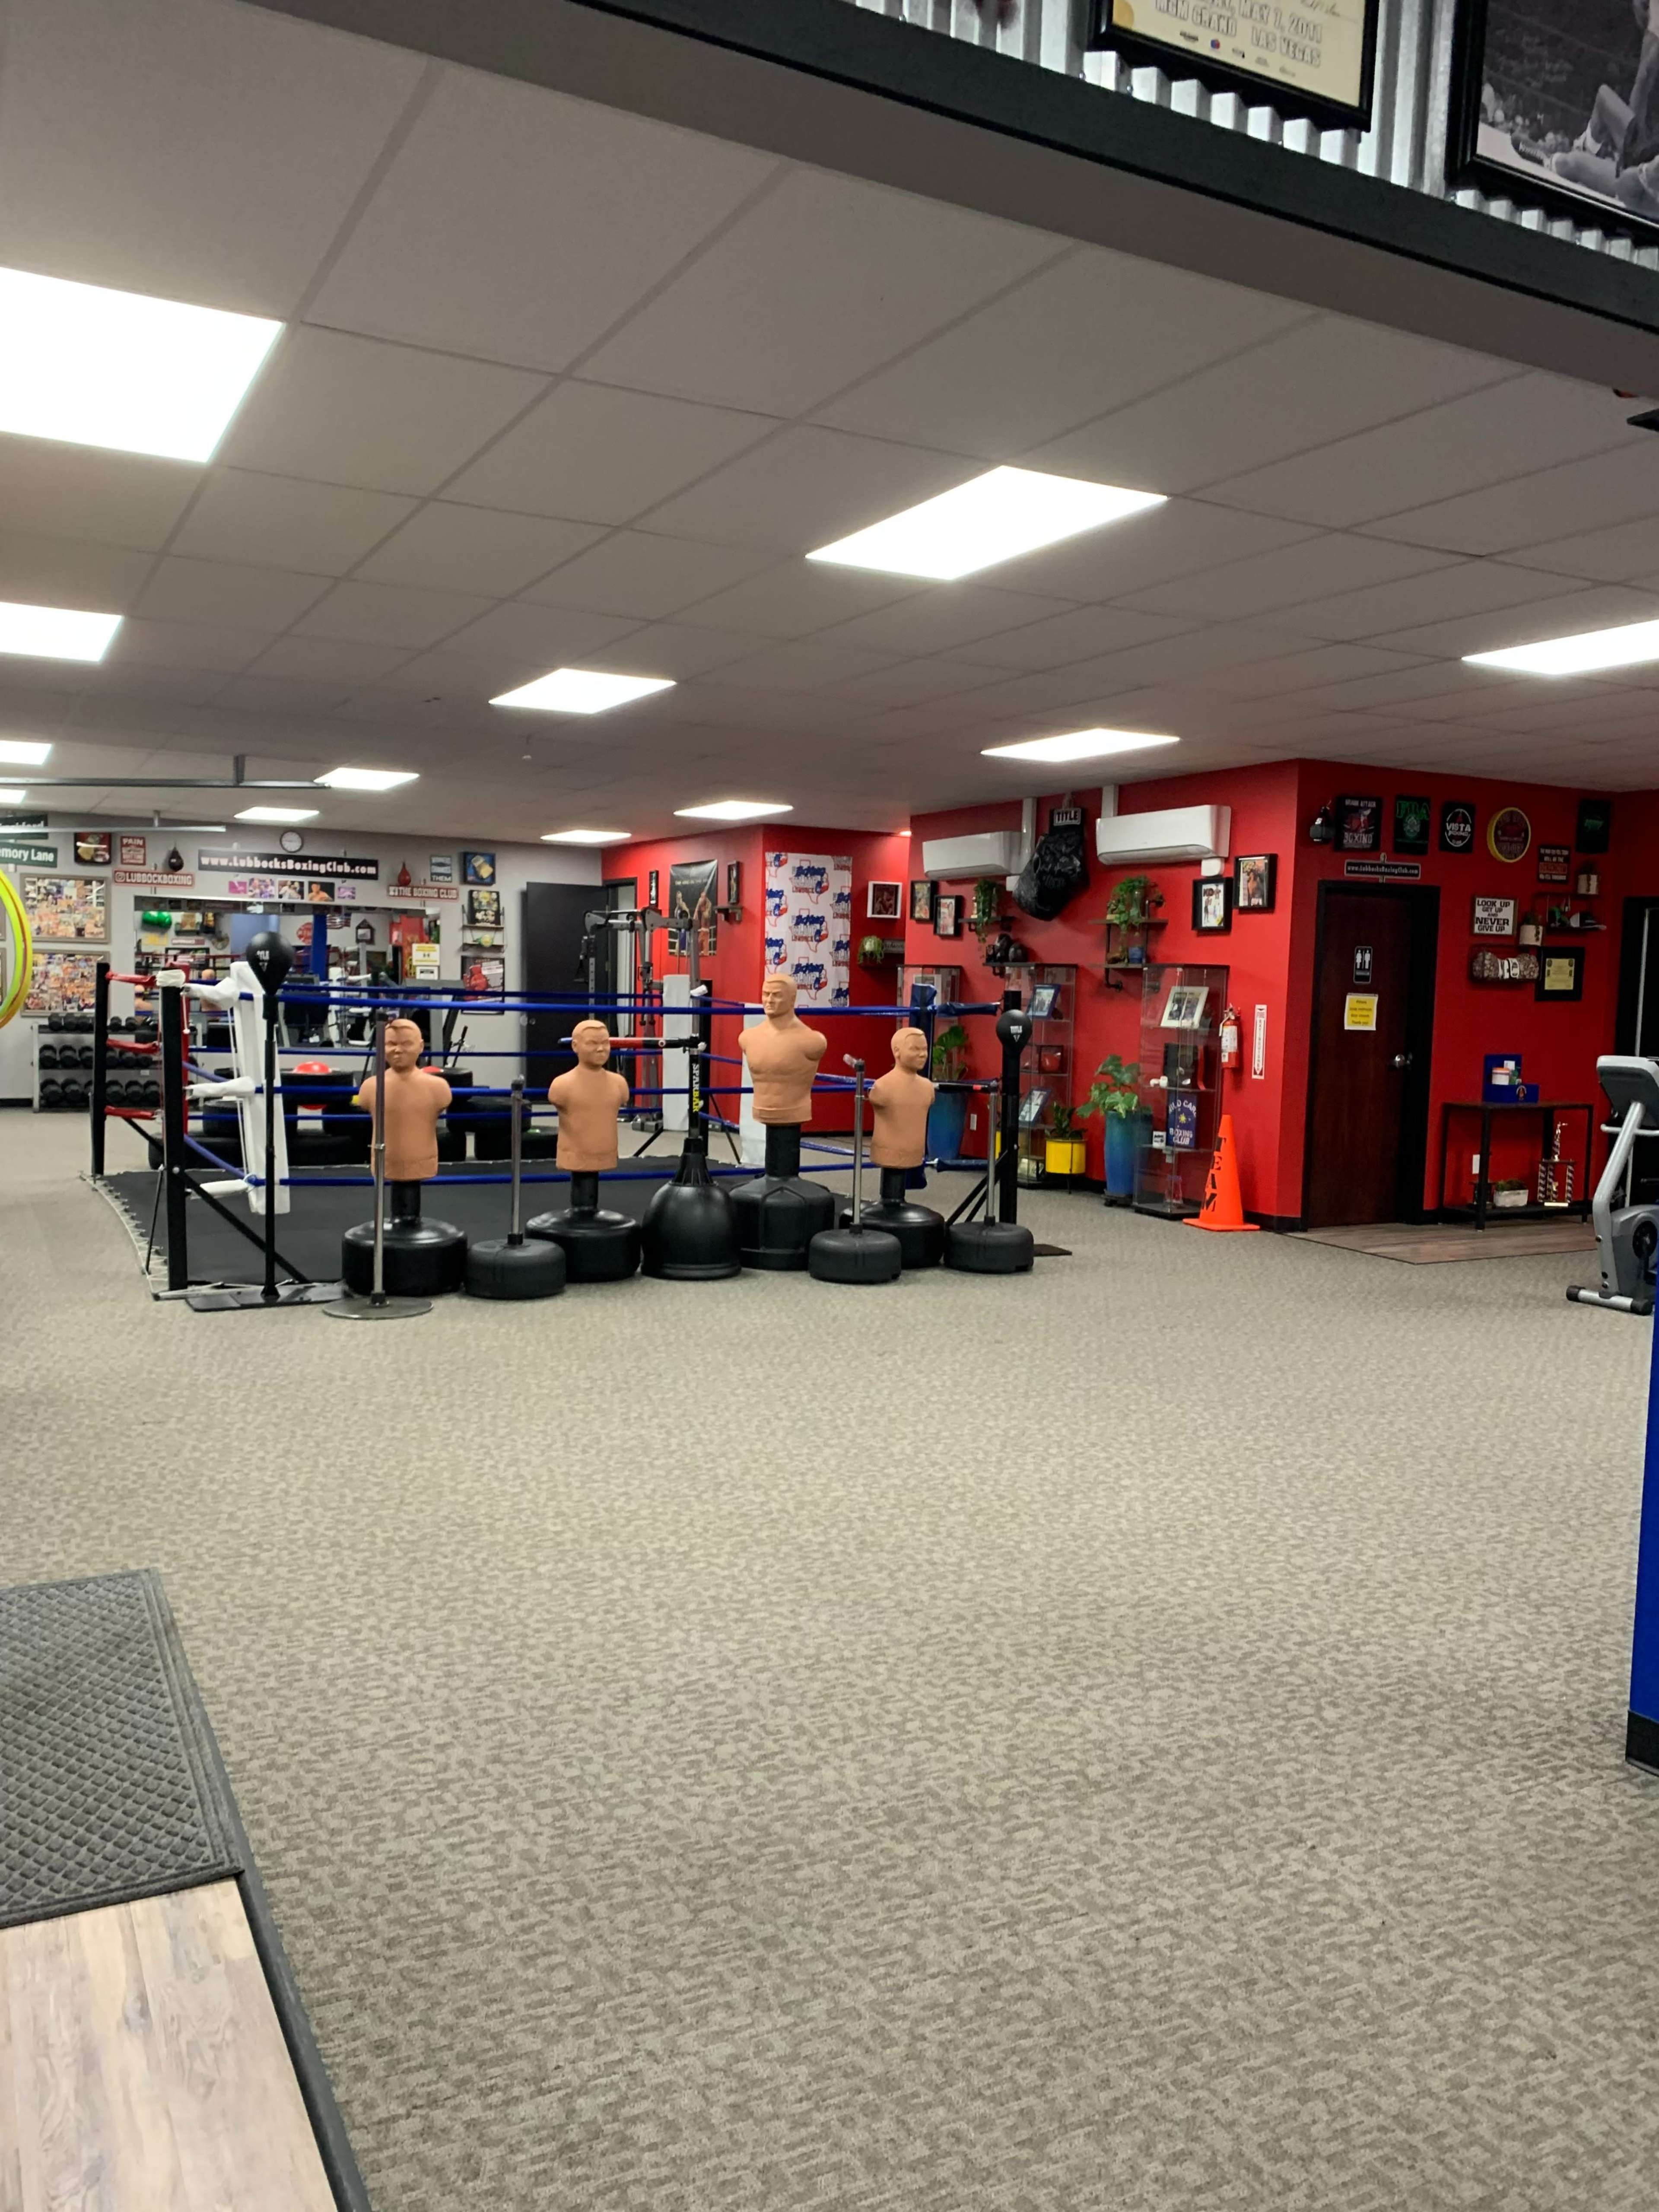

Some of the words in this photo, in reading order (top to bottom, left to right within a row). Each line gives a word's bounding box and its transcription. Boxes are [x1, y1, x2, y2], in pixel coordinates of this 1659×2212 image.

[1239, 0, 1271, 25] MAY
[1192, 4, 1237, 37] GRAND
[1252, 26, 1277, 53] LAS
[1280, 36, 1321, 68] VEGAS
[1055, 811, 1079, 823] TITLE
[1446, 823, 1471, 832] VISTA
[0, 848, 29, 861] mory
[31, 849, 54, 861] Lane
[200, 856, 377, 874] www.LubbocksBoxingClub.com
[126, 873, 192, 885] LUBBOCKBOXING
[399, 887, 411, 896] THE
[413, 888, 438, 897] BOXING
[440, 889, 457, 898] CLUB
[1476, 917, 1509, 925] NEVER
[1170, 1128, 1192, 1138] BOXING
[1173, 1137, 1190, 1145] CLUB
